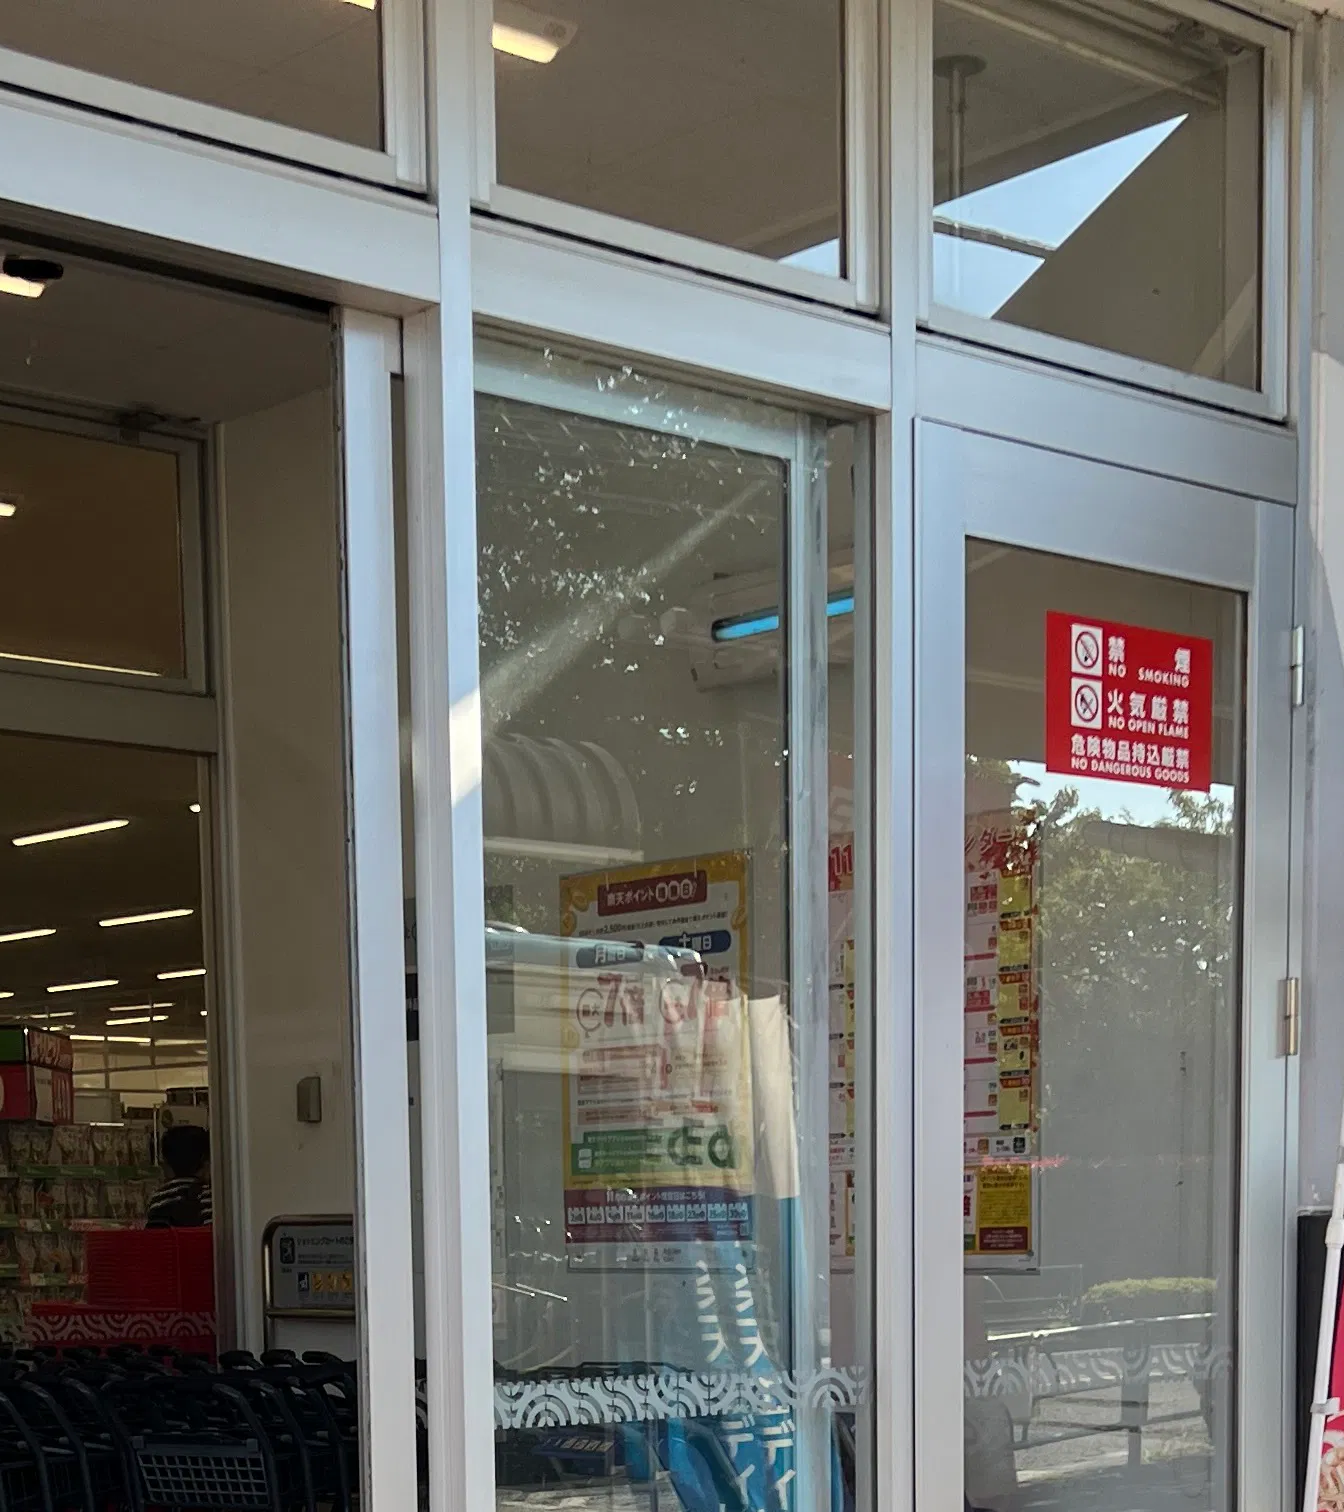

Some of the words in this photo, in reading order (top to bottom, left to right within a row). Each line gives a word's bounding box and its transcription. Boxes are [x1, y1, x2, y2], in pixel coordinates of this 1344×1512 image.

[1108, 663, 1127, 678] NO
[1138, 667, 1190, 688] SMOKING
[1107, 688, 1190, 724] 火気厳禁
[1108, 716, 1125, 730] NO
[1128, 718, 1156, 735] OPEN
[1158, 722, 1190, 739] FLAME
[1071, 757, 1088, 771] NO
[1091, 759, 1152, 779] DANGEROUS
[1154, 767, 1190, 784] GOODS
